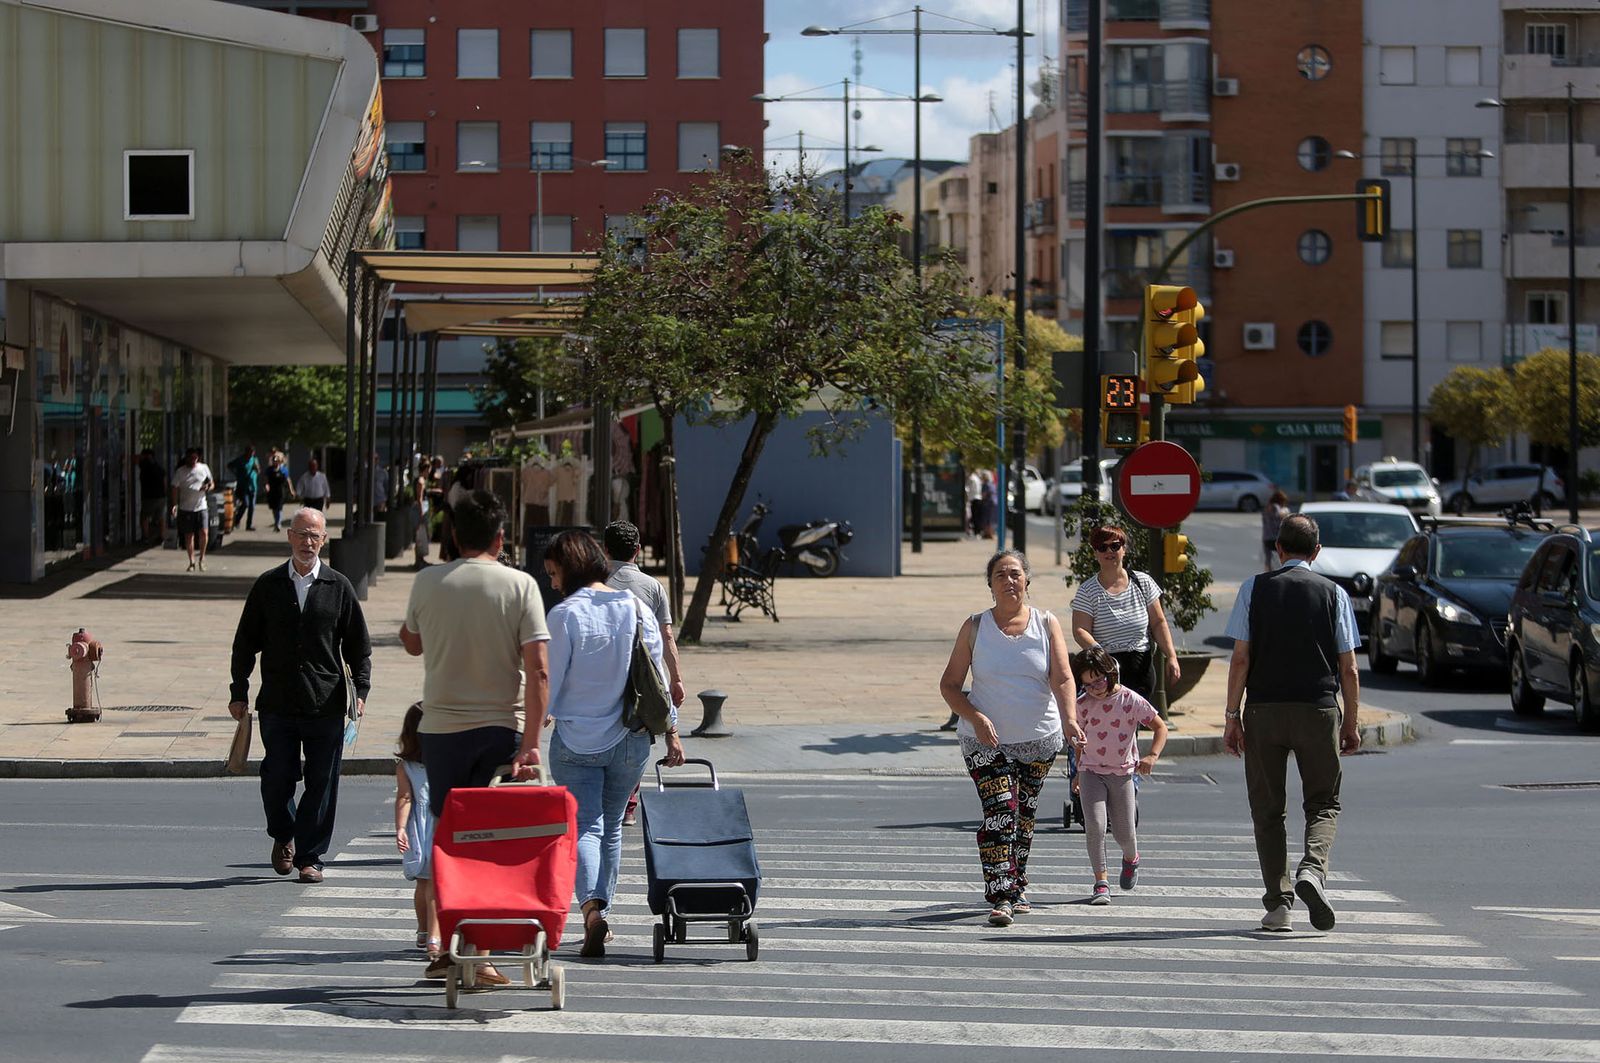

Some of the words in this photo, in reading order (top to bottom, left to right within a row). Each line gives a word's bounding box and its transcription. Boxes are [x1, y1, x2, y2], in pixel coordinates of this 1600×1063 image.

[1107, 378, 1135, 407] 23
[1276, 424, 1311, 436] CAJA
[1314, 424, 1344, 436] RUR
